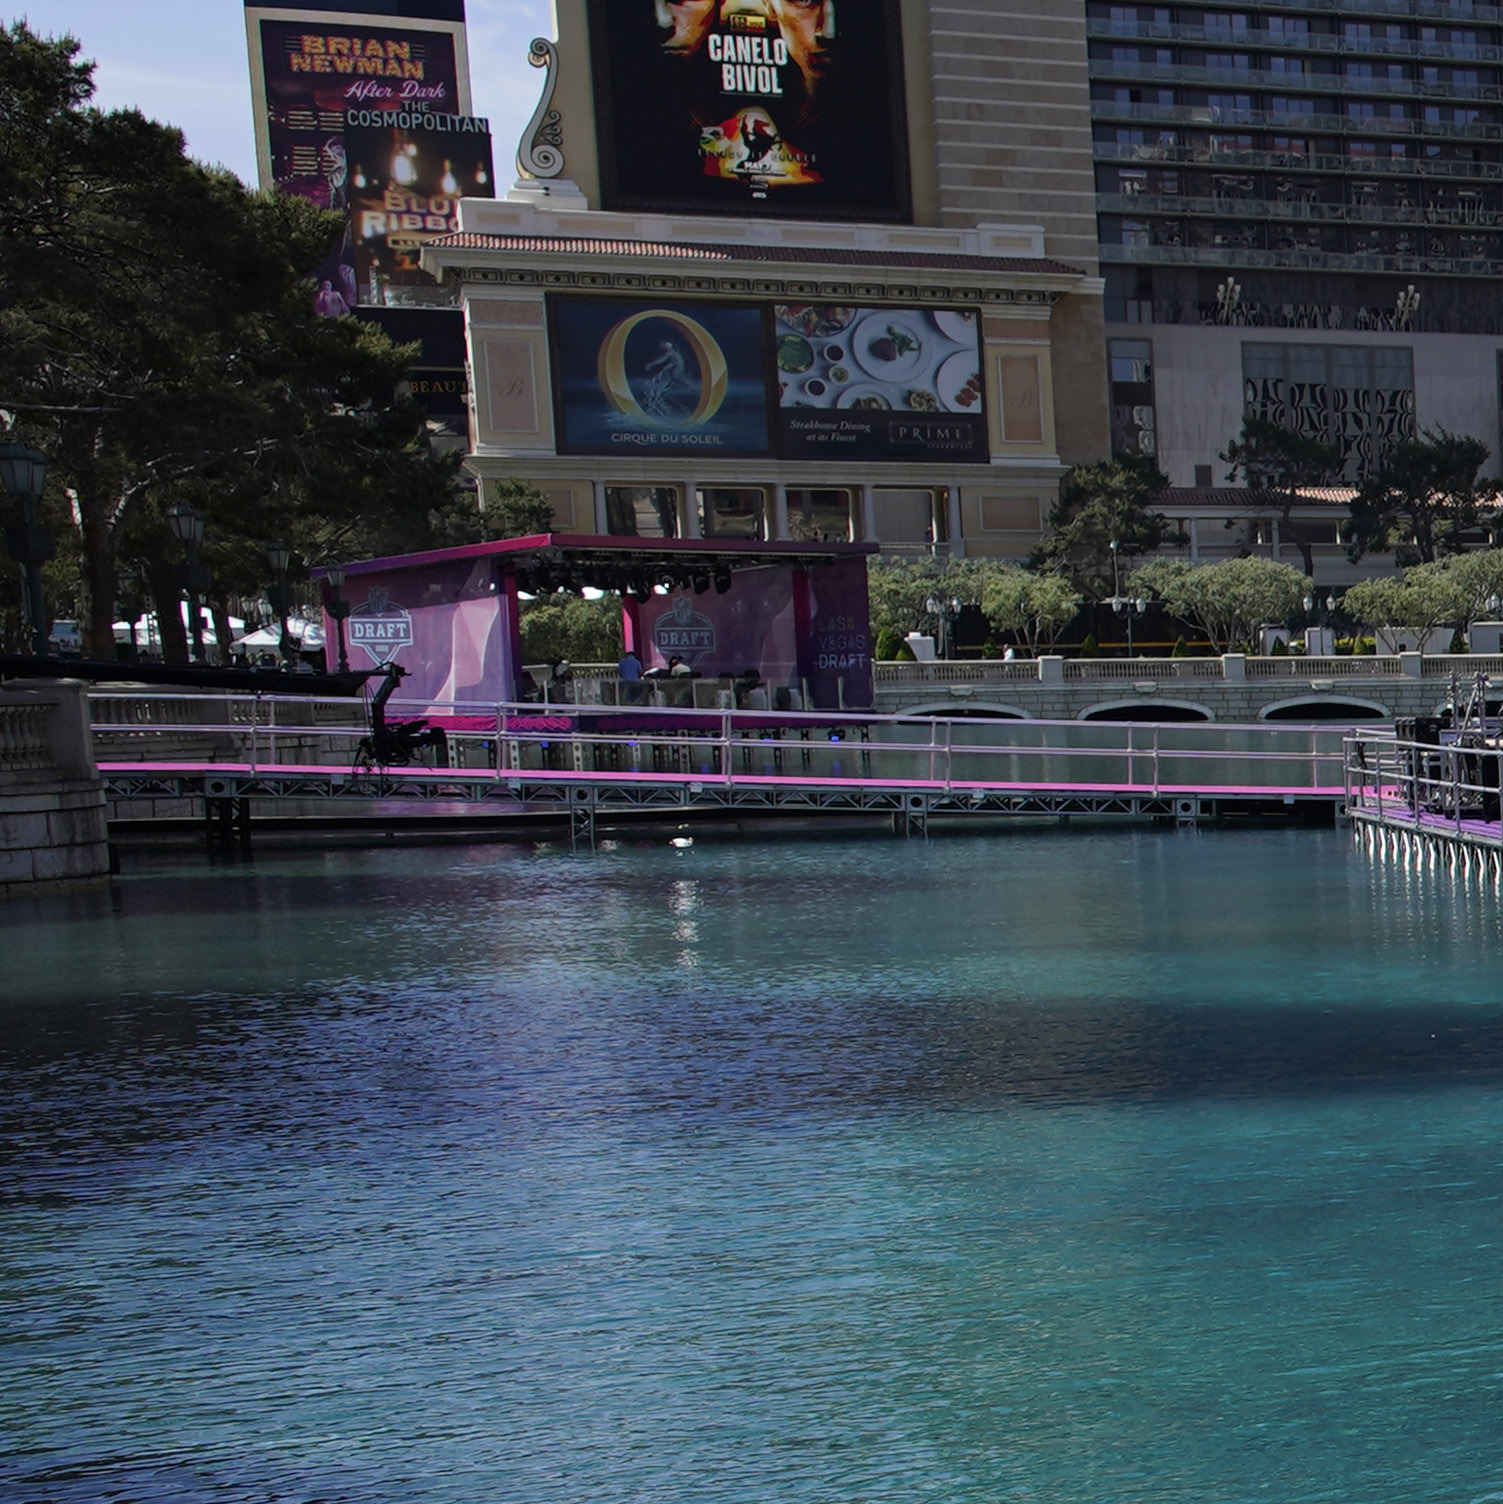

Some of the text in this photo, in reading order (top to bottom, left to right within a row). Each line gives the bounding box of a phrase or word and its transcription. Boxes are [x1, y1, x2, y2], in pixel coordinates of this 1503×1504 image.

[300, 34, 412, 59] BRIAN
[708, 33, 788, 66] CANELO
[289, 53, 424, 80] NEWMAN
[721, 63, 783, 94] BIVOL
[343, 79, 446, 102] After Dark
[402, 101, 430, 113] THE
[346, 107, 488, 133] COSMOPOLITAN
[839, 420, 871, 433] Dining
[611, 432, 723, 446] CIRQUE DU SOLEIL
[354, 623, 407, 638] DRAFT
[659, 631, 711, 646] DRAFT
[818, 652, 867, 669] DRAFT
